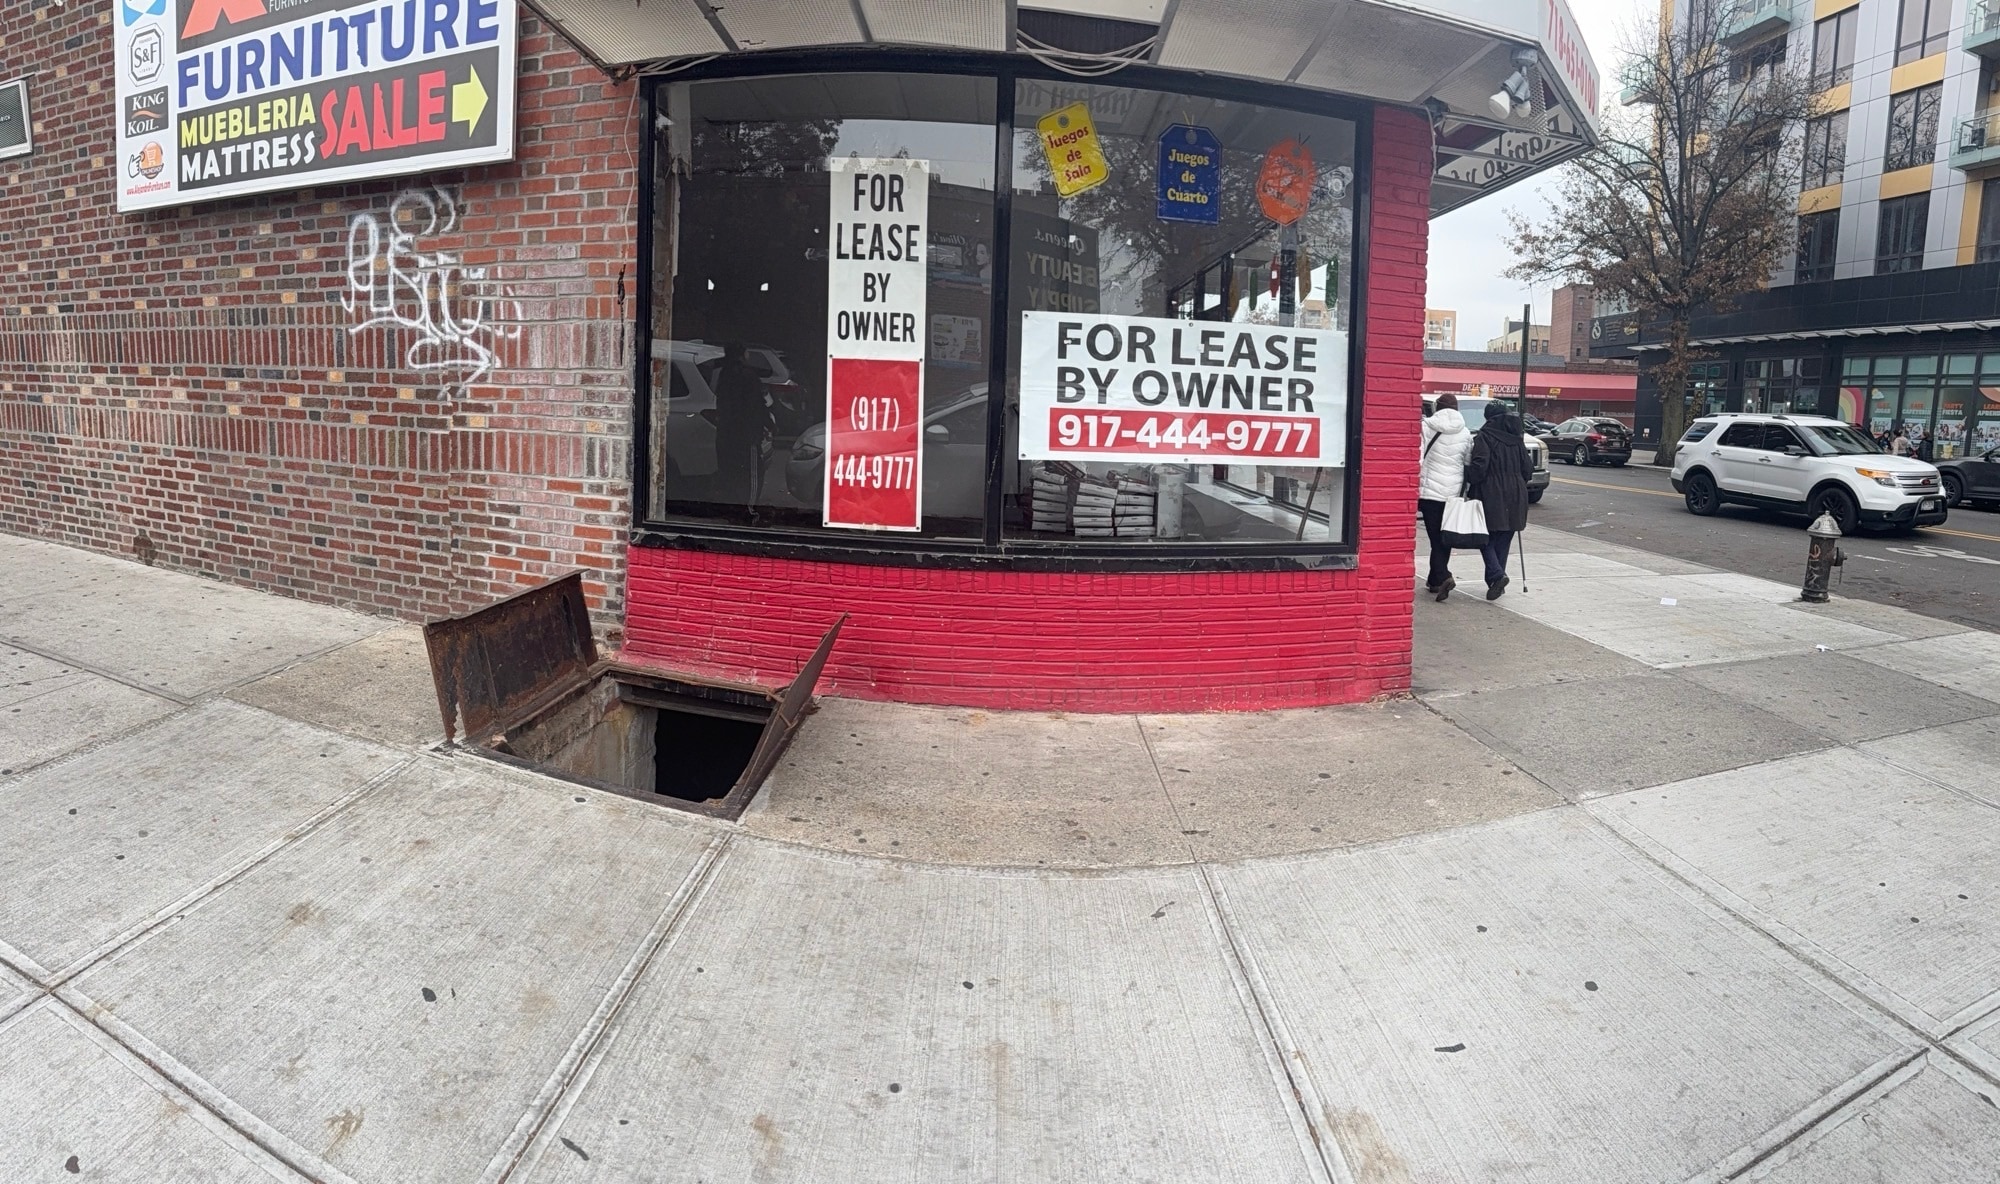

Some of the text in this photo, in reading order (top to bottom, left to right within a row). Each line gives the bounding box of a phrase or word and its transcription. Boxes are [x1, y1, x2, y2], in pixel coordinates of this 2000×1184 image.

[134, 41, 158, 68] S&F
[132, 91, 165, 111] KING
[180, 92, 317, 149] MUEBLERIA
[181, 130, 316, 183] MATTRESS
[1065, 163, 1092, 182] Sala
[1066, 149, 1083, 163] de
[1168, 148, 1209, 168] Juegos
[854, 173, 904, 212] FOR
[1181, 170, 1196, 184] de
[1167, 187, 1209, 205] Cuarto
[836, 222, 920, 262] LEASE
[863, 272, 892, 303] BY
[837, 310, 916, 342] OWNER
[1057, 321, 1317, 373] FOR LEASE
[1056, 366, 1315, 413] BY OWNER
[850, 396, 900, 432] (917)
[1057, 414, 1312, 453] 917-444-9777
[834, 454, 914, 490] 444-9777
